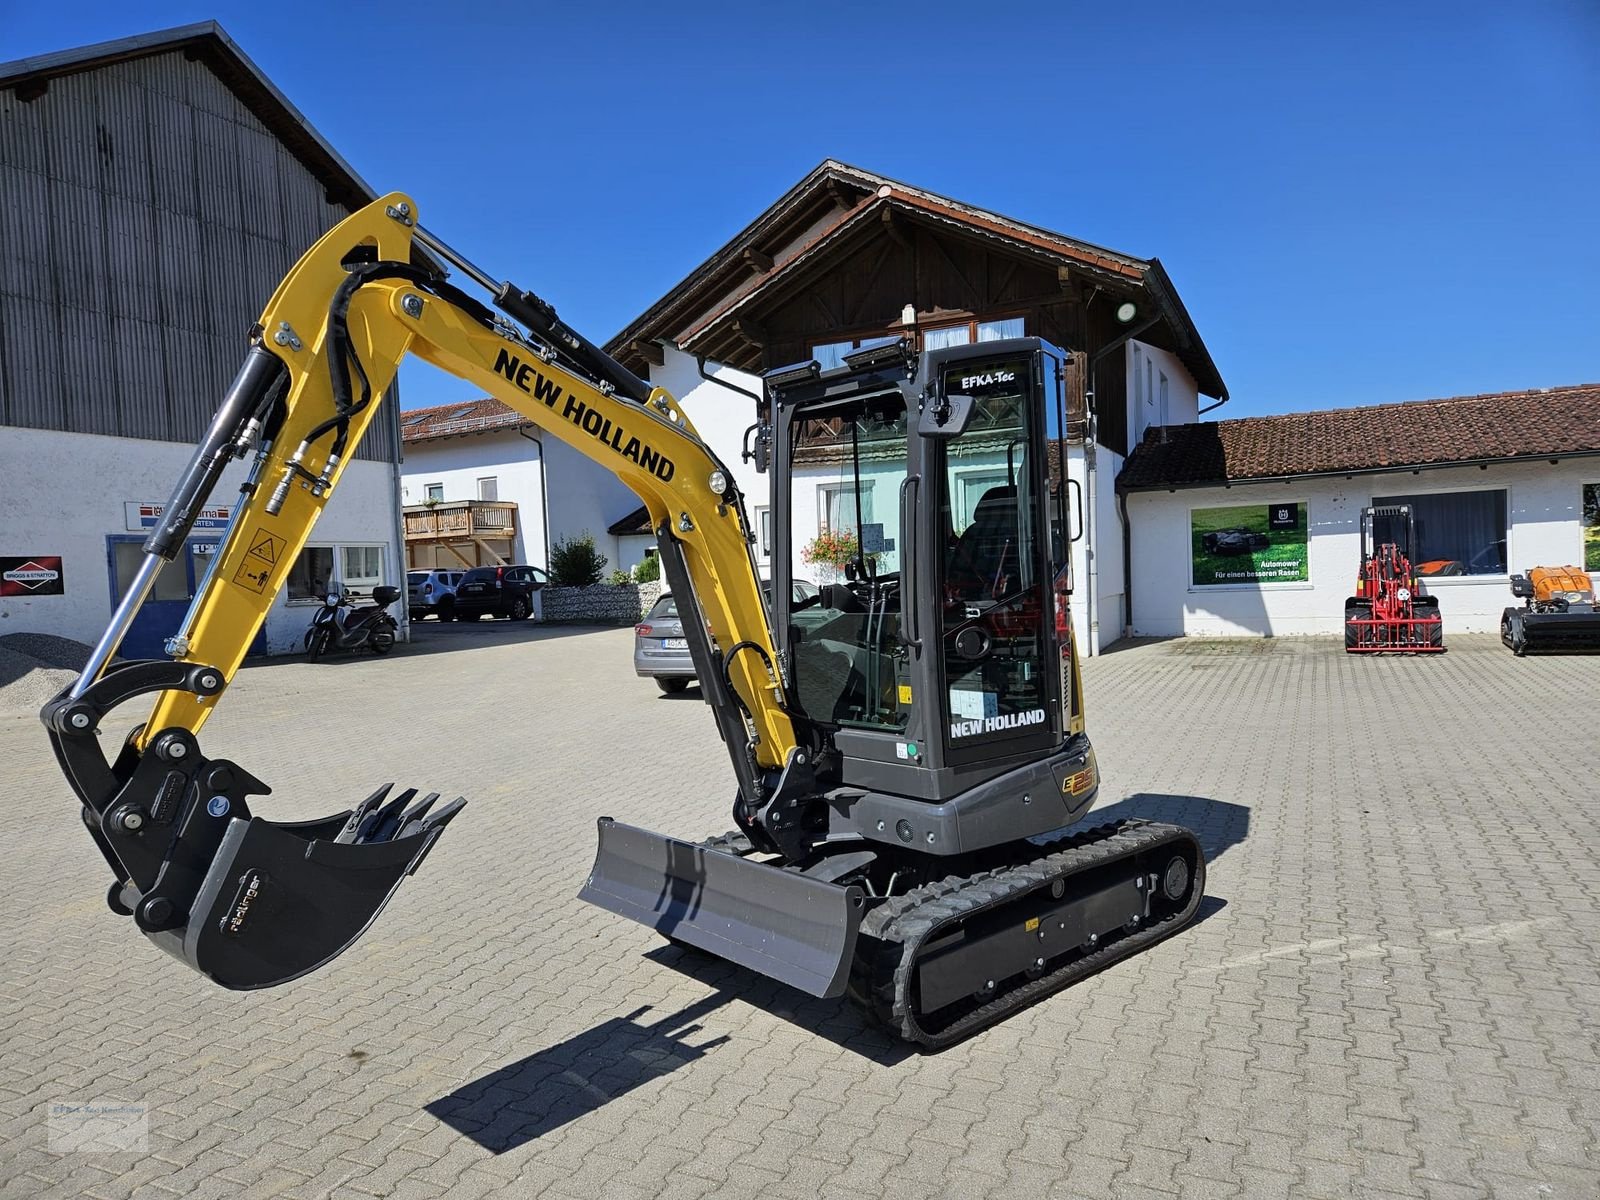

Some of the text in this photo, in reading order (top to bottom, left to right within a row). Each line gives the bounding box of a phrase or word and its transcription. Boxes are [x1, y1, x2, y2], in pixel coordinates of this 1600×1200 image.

[961, 370, 1015, 389] EFKA-Tec
[493, 348, 675, 483] NEW HOLLAND
[1215, 571, 1226, 579] Für
[951, 709, 1046, 738] NEW HOLLAND
